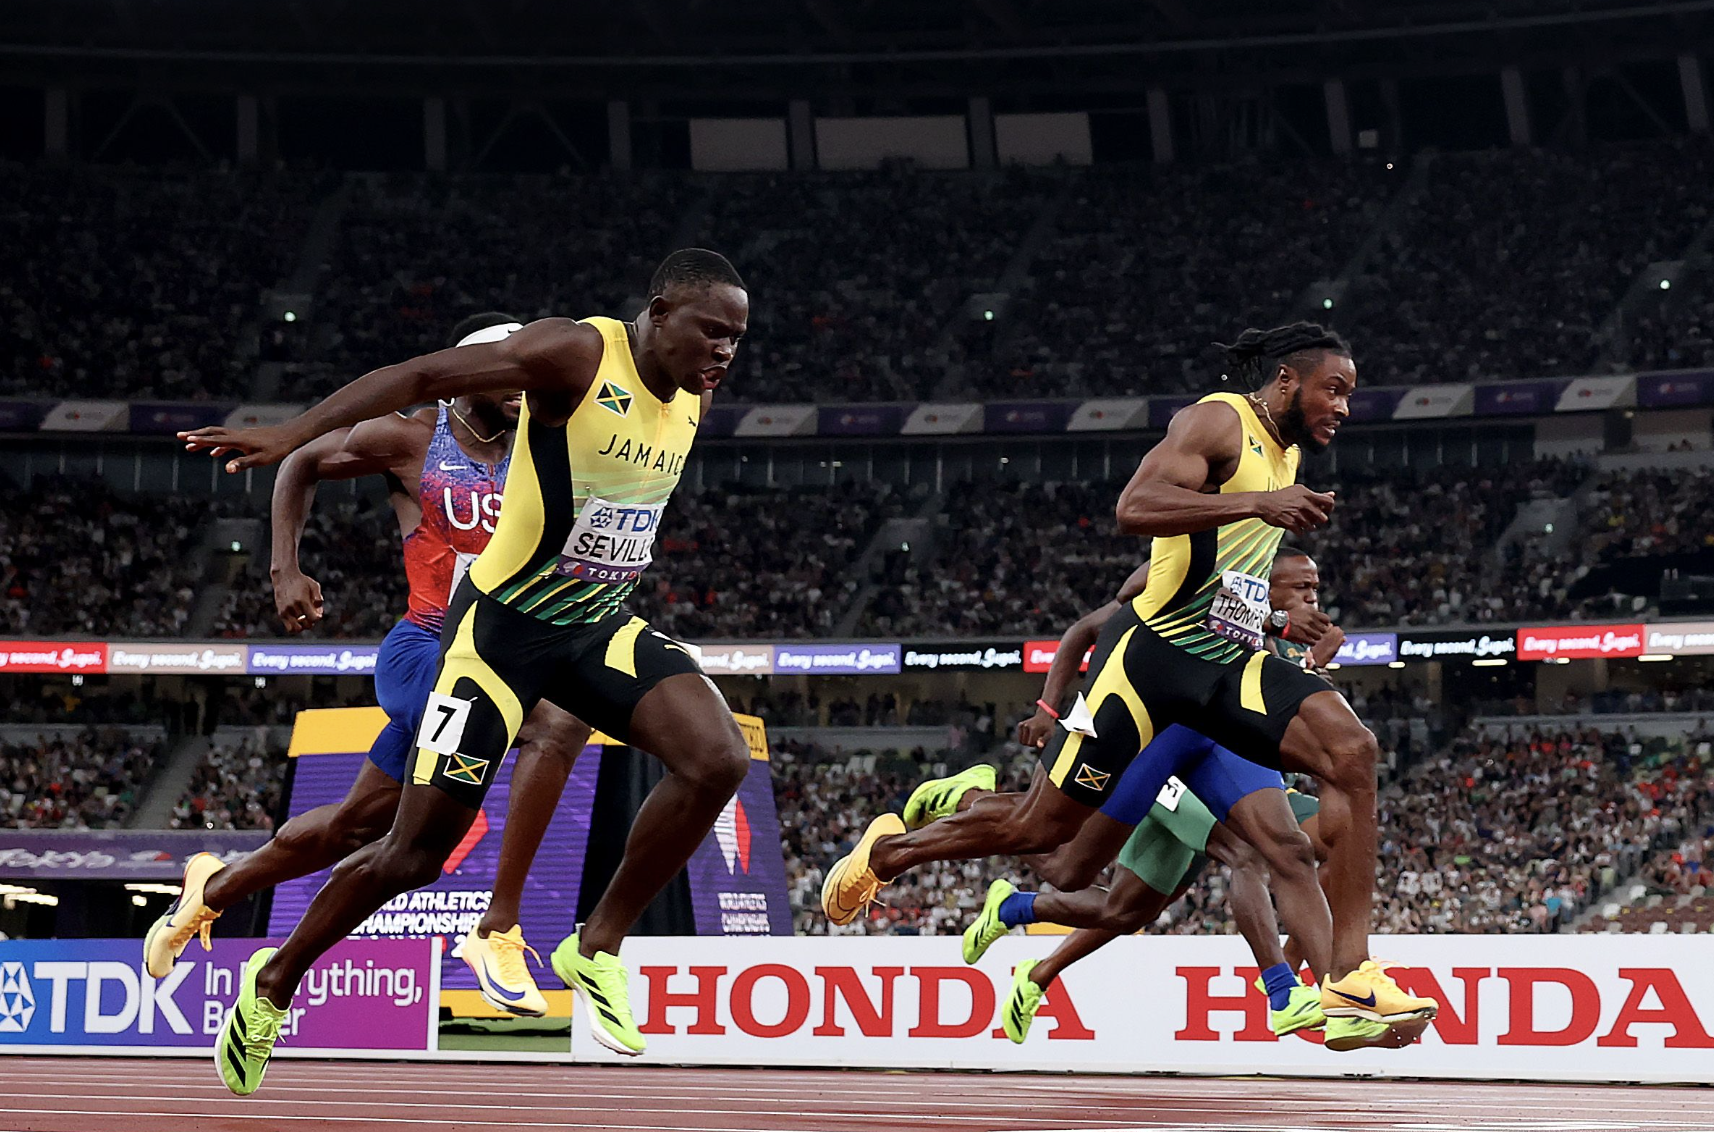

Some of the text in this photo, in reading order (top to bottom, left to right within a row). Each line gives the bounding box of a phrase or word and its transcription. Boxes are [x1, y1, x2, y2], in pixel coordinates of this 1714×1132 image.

[598, 434, 685, 475] JAMAIC
[444, 487, 503, 533] US
[574, 532, 654, 562] SEVILL
[1244, 579, 1267, 603] TD
[1400, 641, 1433, 658] Every
[1523, 637, 1557, 654] Every
[1649, 632, 1684, 650] Every
[112, 650, 150, 669] Every
[252, 652, 289, 670] Every
[778, 653, 812, 670] Every
[904, 651, 938, 668] Every
[430, 704, 458, 742] 7
[408, 891, 493, 911] ATHLETICS
[350, 912, 486, 934] HAMPIONSHIP
[205, 961, 232, 995] In
[35, 962, 196, 1034] TDK
